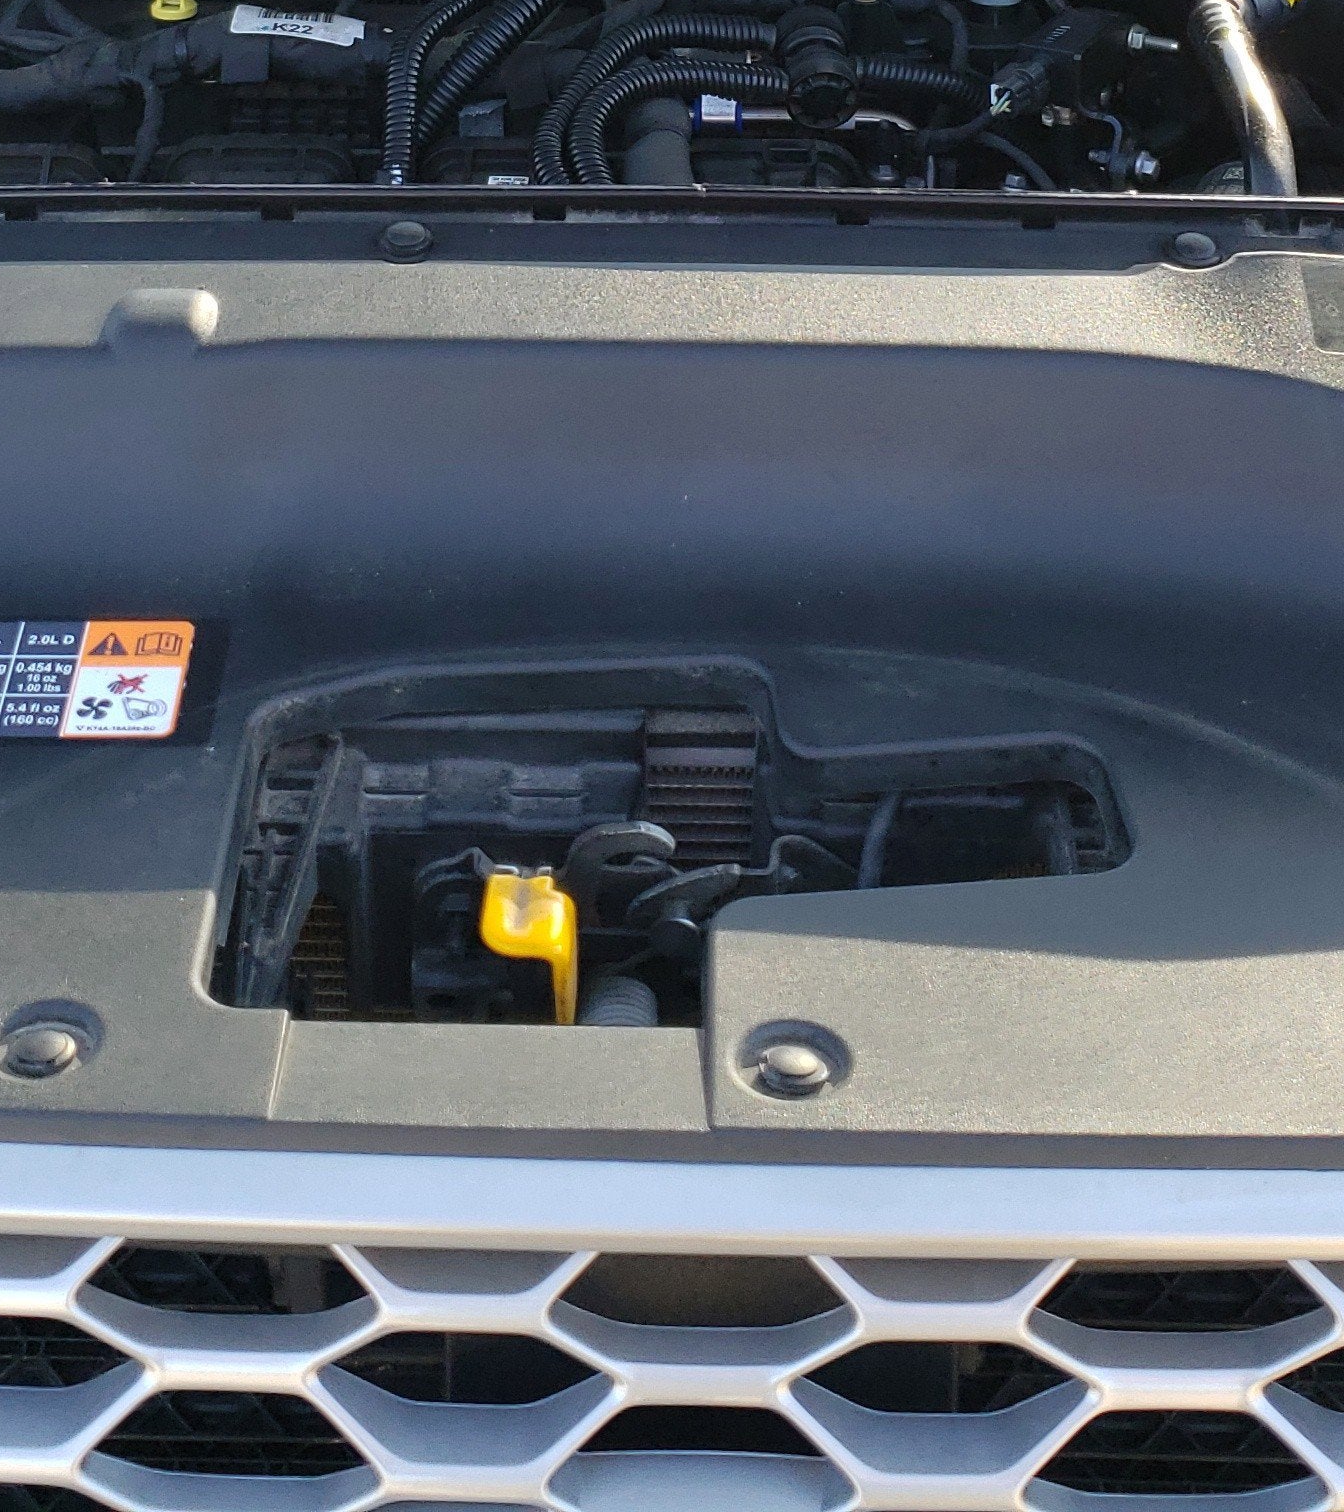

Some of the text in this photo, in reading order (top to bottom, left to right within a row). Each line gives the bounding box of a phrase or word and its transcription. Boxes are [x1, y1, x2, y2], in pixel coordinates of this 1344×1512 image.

[272, 22, 314, 35] K22
[27, 634, 75, 645] 2.0L D
[15, 661, 73, 675] 0.454 kg
[42, 675, 57, 683] oz
[17, 683, 61, 692] 1.00 lbs
[6, 702, 60, 713] 5.4 fl oz
[4, 713, 59, 727] (160 cc)
